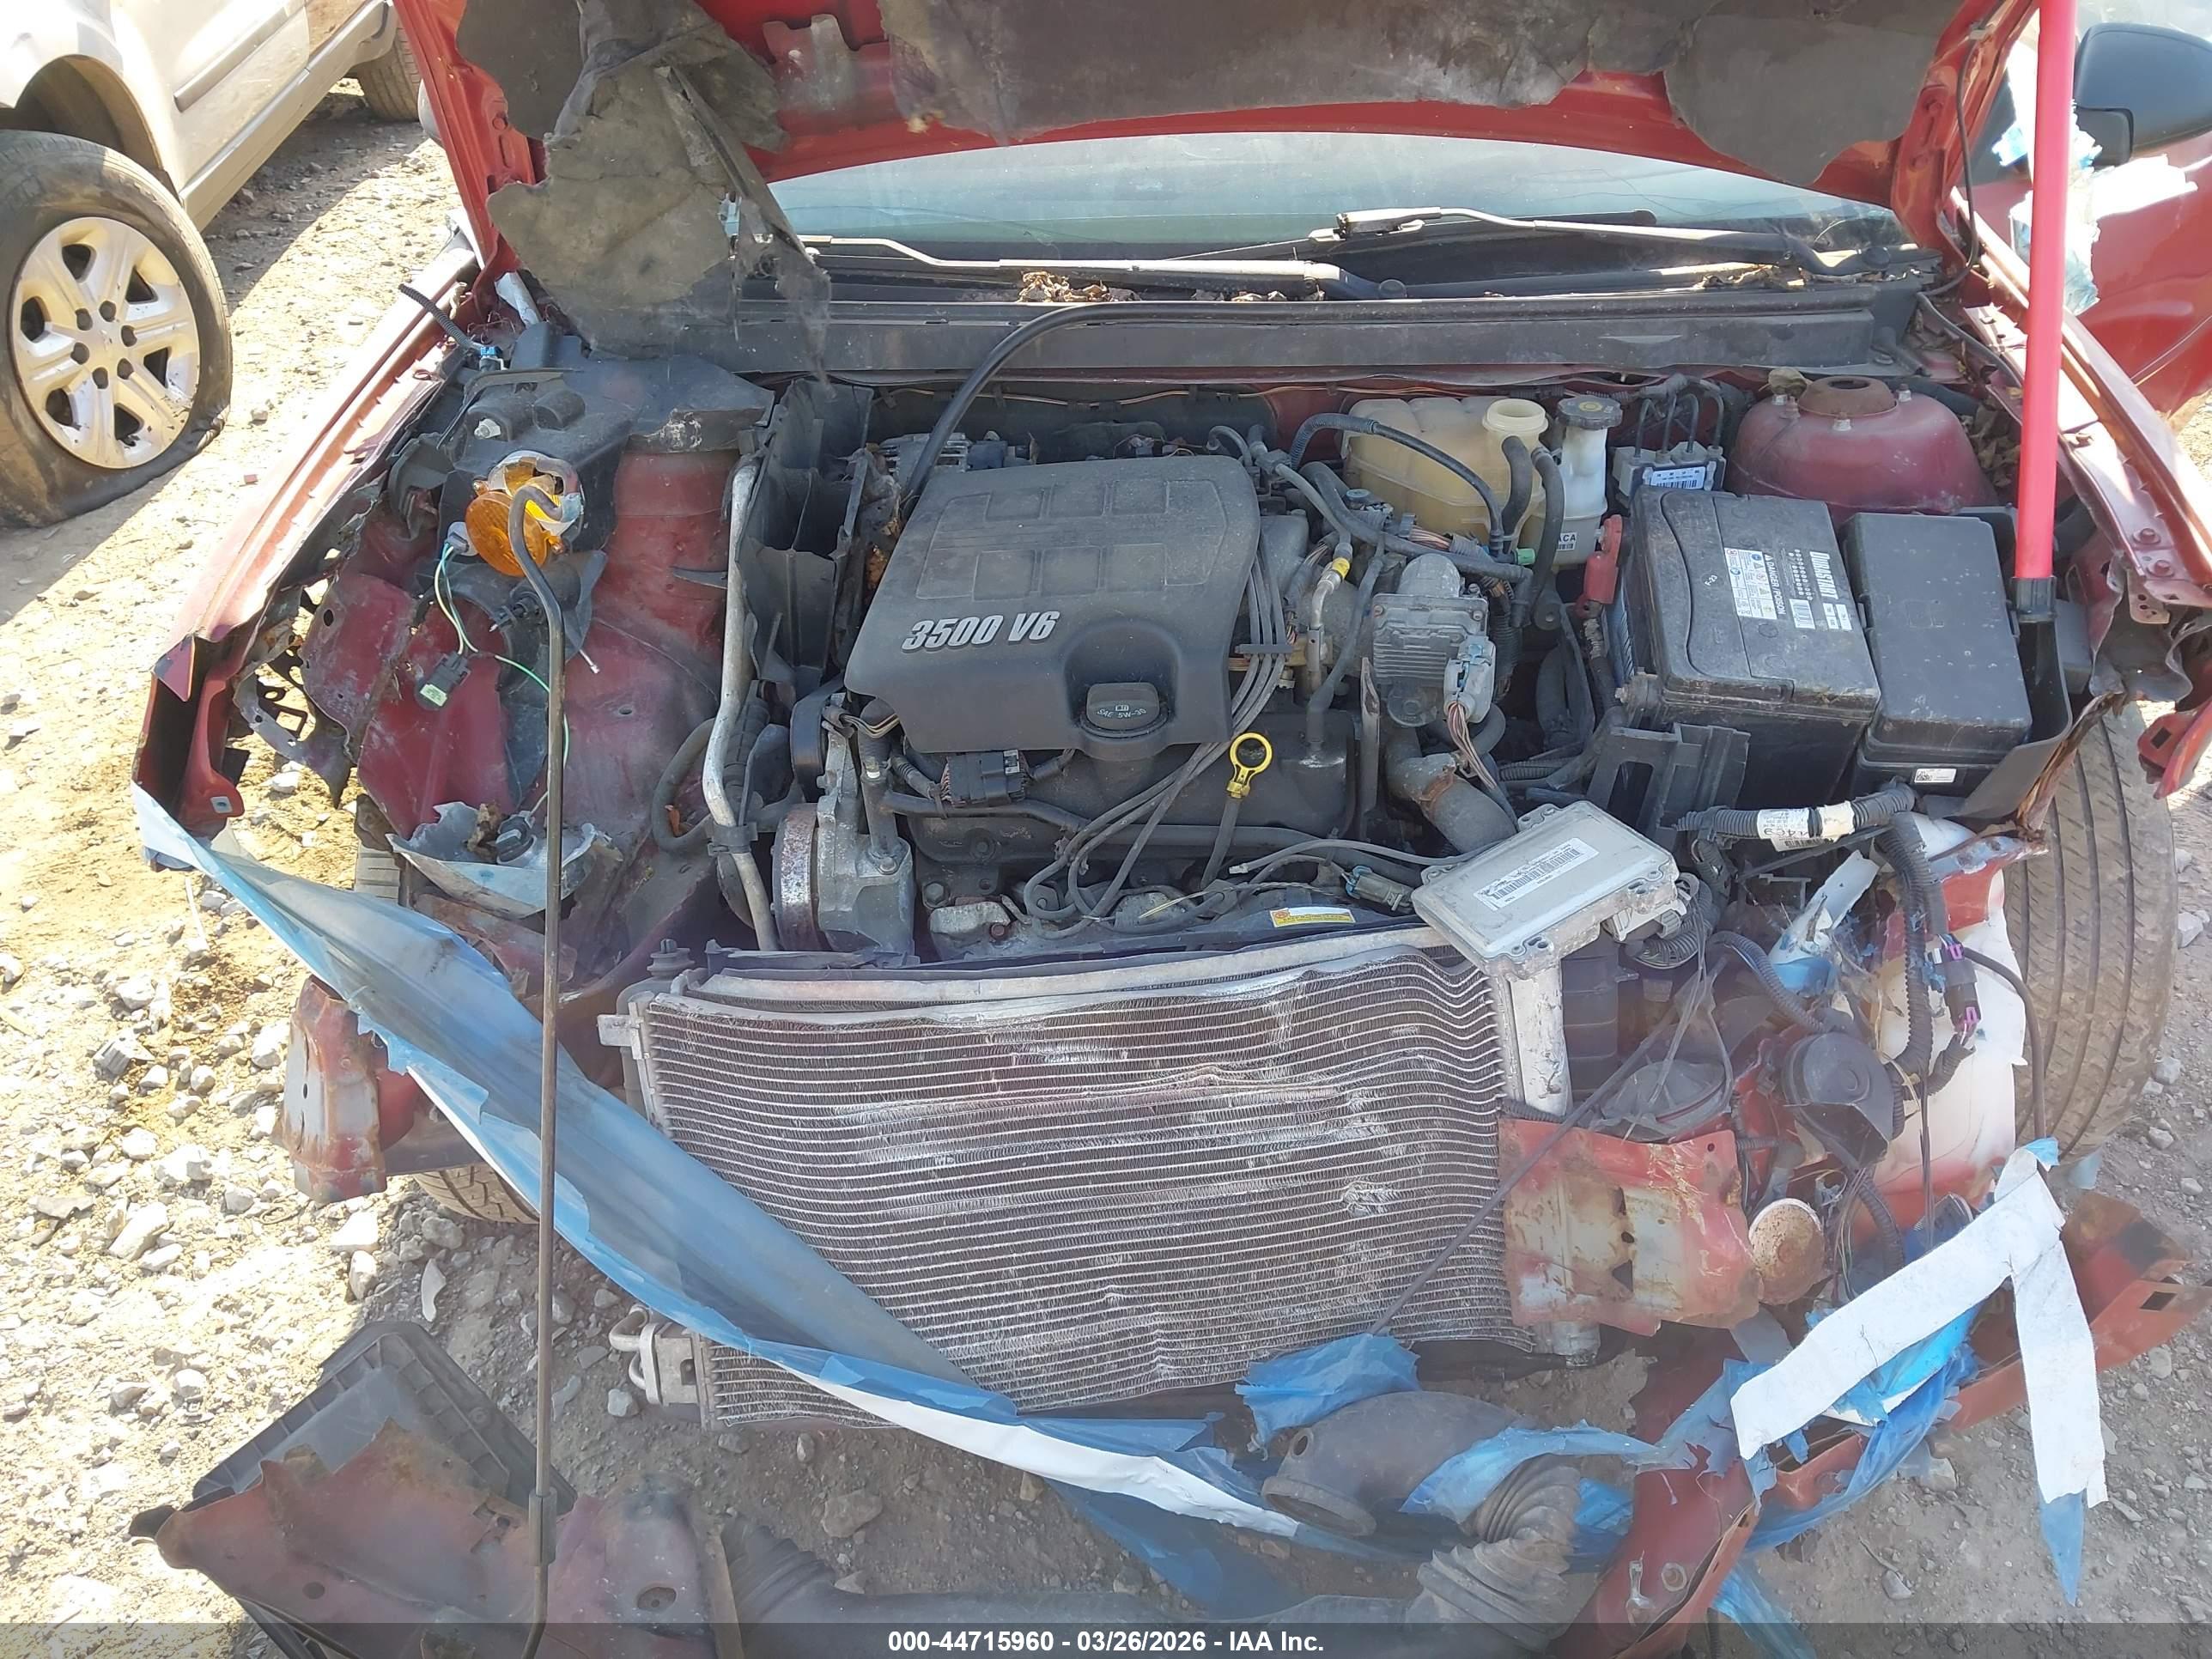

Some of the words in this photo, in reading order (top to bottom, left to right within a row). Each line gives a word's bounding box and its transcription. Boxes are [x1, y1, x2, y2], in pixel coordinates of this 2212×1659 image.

[1809, 551, 1838, 599] DURASTART
[902, 615, 1003, 651] 3500
[1008, 611, 1060, 641] V6
[1097, 708, 1114, 718] SAE
[1118, 708, 1146, 718] 5W-30
